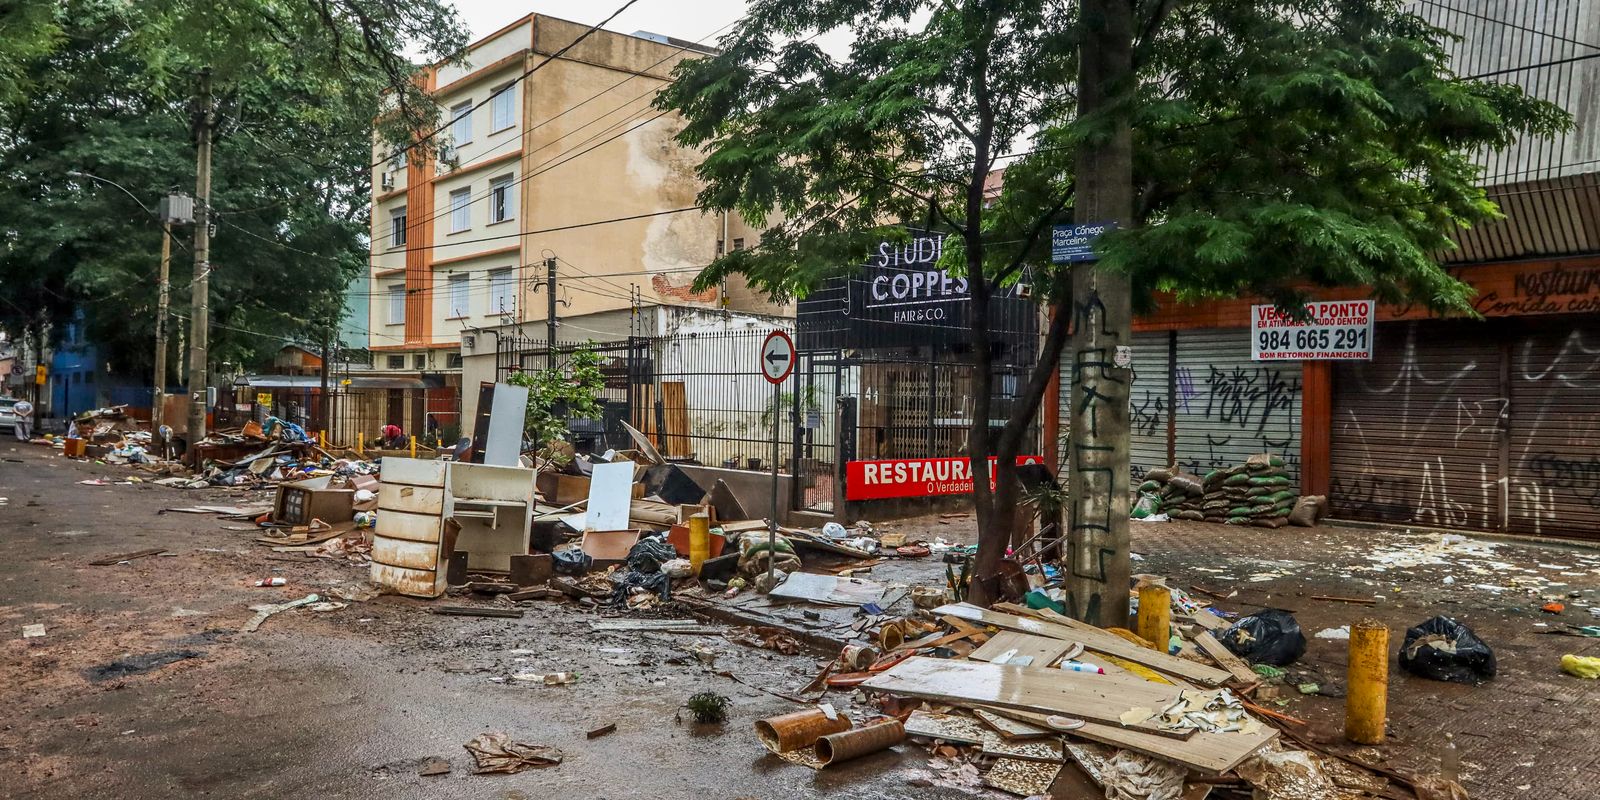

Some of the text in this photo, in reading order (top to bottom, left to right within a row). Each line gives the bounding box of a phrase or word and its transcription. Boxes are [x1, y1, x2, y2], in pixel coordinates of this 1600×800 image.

[1052, 229, 1072, 238] Praça
[1052, 236, 1087, 247] Marcelino
[878, 235, 943, 267] STUDI
[873, 269, 968, 301] COPPES
[1320, 302, 1368, 318] PONTO
[1475, 291, 1561, 315] Comida
[1257, 320, 1267, 328] EM
[1315, 318, 1335, 326] TUDO
[1337, 317, 1368, 326] DENTRO
[1259, 328, 1367, 351] 984 665 291
[1316, 351, 1369, 359] FINANCEIRO
[864, 459, 998, 485] RESTAURA
[927, 482, 934, 493] O
[936, 480, 974, 494] Verdadeir
